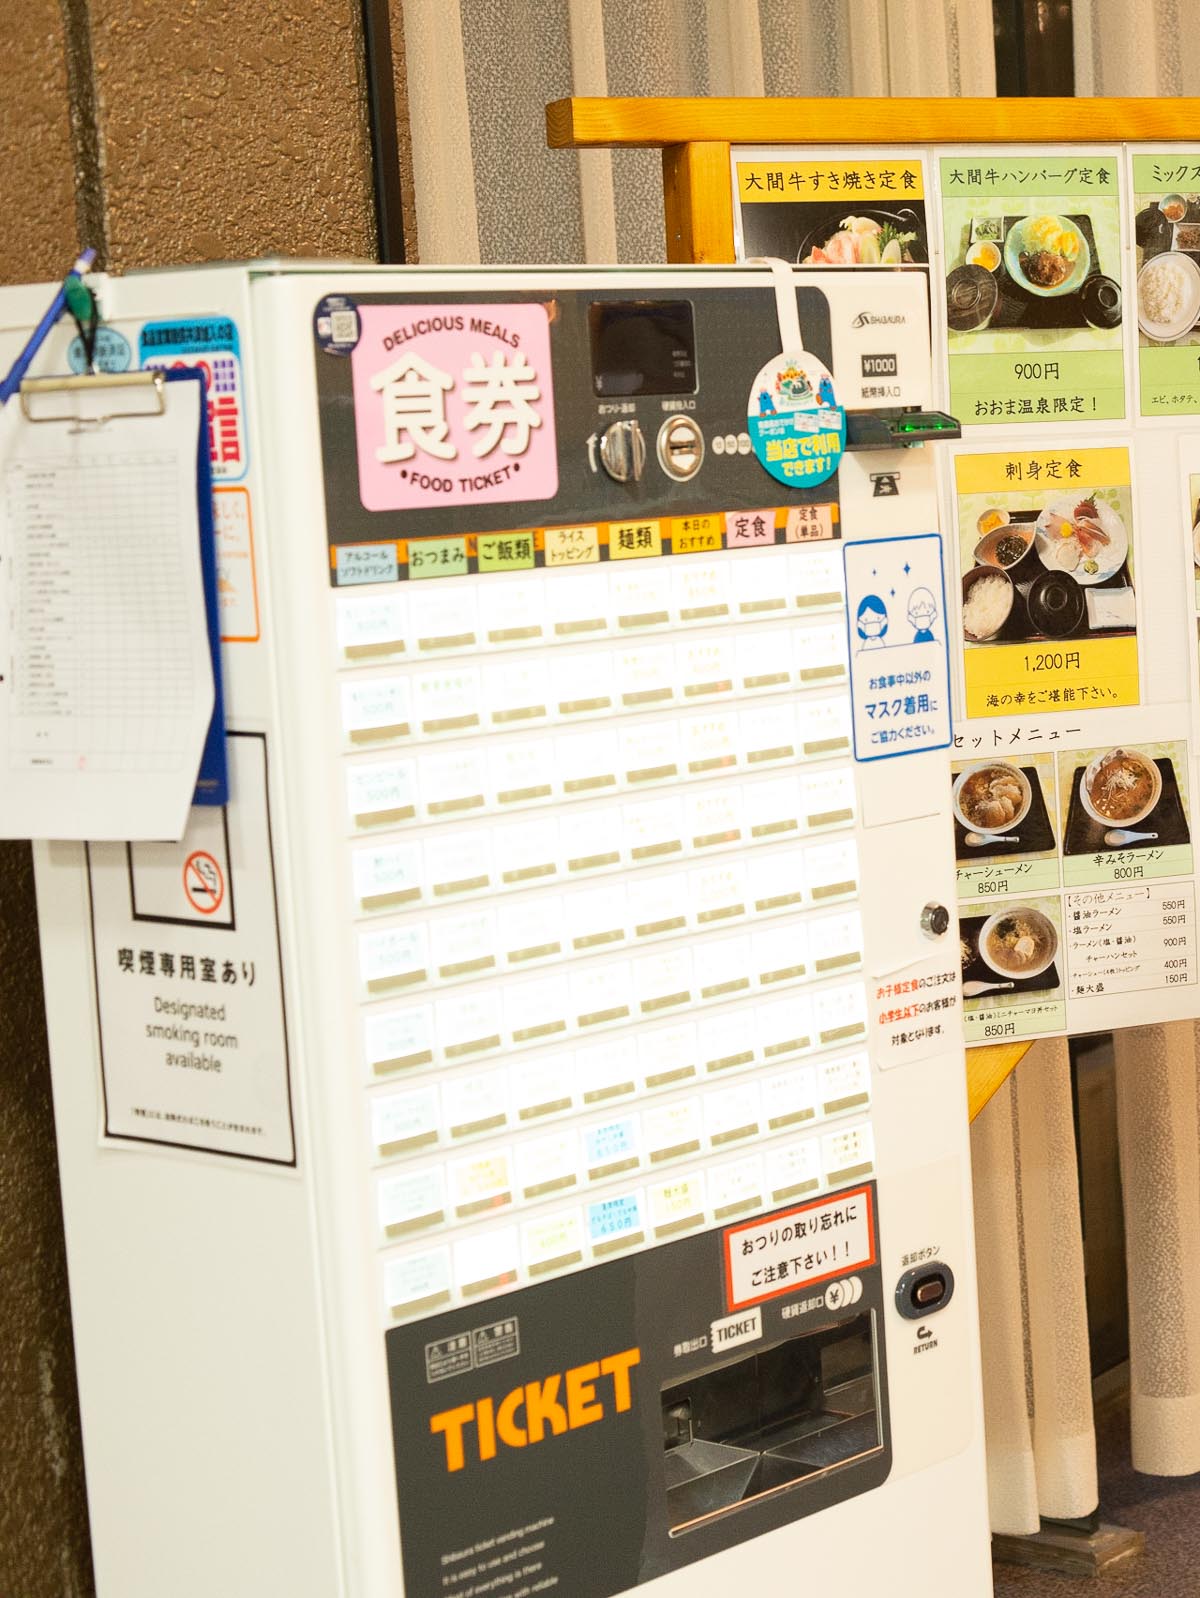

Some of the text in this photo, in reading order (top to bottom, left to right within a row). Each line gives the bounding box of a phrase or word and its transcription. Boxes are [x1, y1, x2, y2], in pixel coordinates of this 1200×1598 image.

[745, 169, 918, 192] 大間牛すき焼き定食
[949, 167, 1111, 187] 大間牛ハンバーグ定食
[383, 315, 522, 352] DELICIOUS MEALS
[863, 358, 896, 373] ¥1000
[1014, 362, 1060, 380] 900円
[370, 350, 542, 464] 食券
[974, 395, 1098, 417] おおま温泉限定！
[766, 432, 841, 462] 当店で利用
[781, 456, 832, 477] できます！
[1005, 458, 1083, 480] 刺身定食
[410, 466, 512, 493] FOOD TICKET
[799, 506, 818, 521] 定食
[682, 519, 710, 532] 本日の
[735, 516, 766, 538] 定食
[795, 524, 824, 539] (単品)
[557, 530, 584, 542] ライス
[618, 526, 653, 550] 麺類
[679, 536, 715, 549] おすすめ
[412, 547, 465, 567] おつまみ
[483, 539, 531, 560] ご飯類
[551, 546, 594, 560] トッピング
[1024, 652, 1080, 672] 1,200円
[869, 670, 931, 690] お食事中以外の
[864, 694, 938, 720] マスク着用に
[986, 686, 1119, 708] 海の幸をご堪能下さい。
[870, 724, 935, 744] ご協力ください。
[1093, 849, 1165, 866] 辛みそラーメン
[1114, 865, 1144, 879] 800円
[978, 879, 1008, 894] 850円
[1068, 887, 1150, 907] 【その他メニュー】
[1162, 899, 1185, 910] 550円
[1162, 914, 1186, 925] 550円
[1163, 936, 1187, 947] 900円
[118, 947, 256, 987] 喫煙専用室あり
[1164, 958, 1187, 969] 400円
[1165, 972, 1188, 983] 150円
[153, 996, 226, 1022] Designated
[145, 1024, 238, 1048] smoking room
[984, 1022, 1015, 1036] 850円
[165, 1051, 222, 1073] available
[741, 1204, 857, 1256] おつりの取り忘れに
[751, 1240, 851, 1287] ご注意下さい！！
[716, 1317, 757, 1343] TICKET
[913, 1339, 938, 1355] RETURN
[430, 1347, 641, 1474] TICKET
